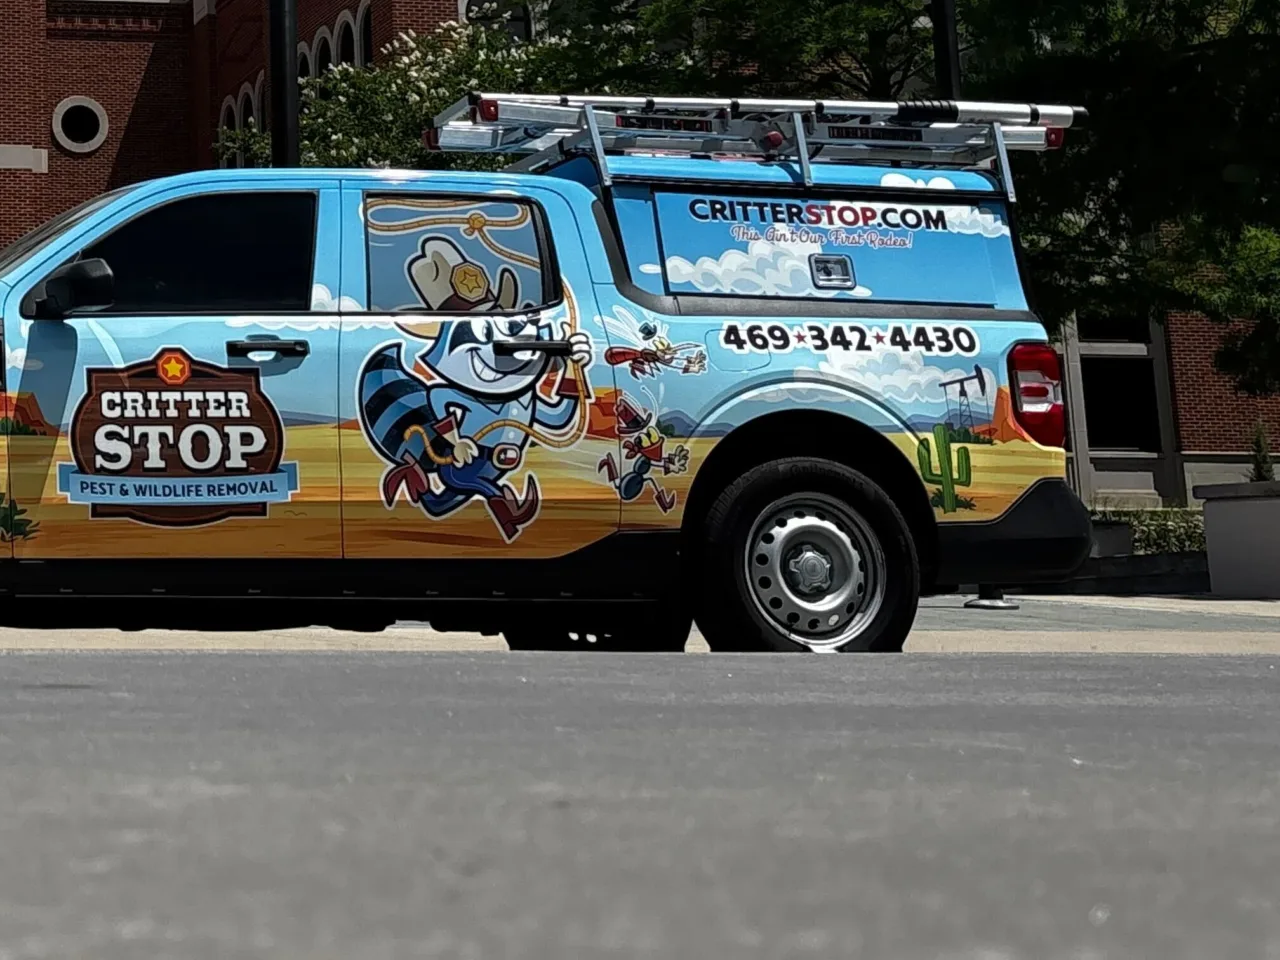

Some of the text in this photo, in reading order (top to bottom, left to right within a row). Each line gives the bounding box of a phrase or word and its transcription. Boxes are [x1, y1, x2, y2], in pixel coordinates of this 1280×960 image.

[689, 198, 948, 231] CRITTERSTOP.COM
[731, 225, 914, 248] This Ain't Our First Rodeo!
[889, 326, 977, 353] 4430
[101, 391, 252, 418] CRITTER
[94, 423, 268, 471] STOP
[80, 479, 278, 498] PEST & WILDLIFE REMOVAL
